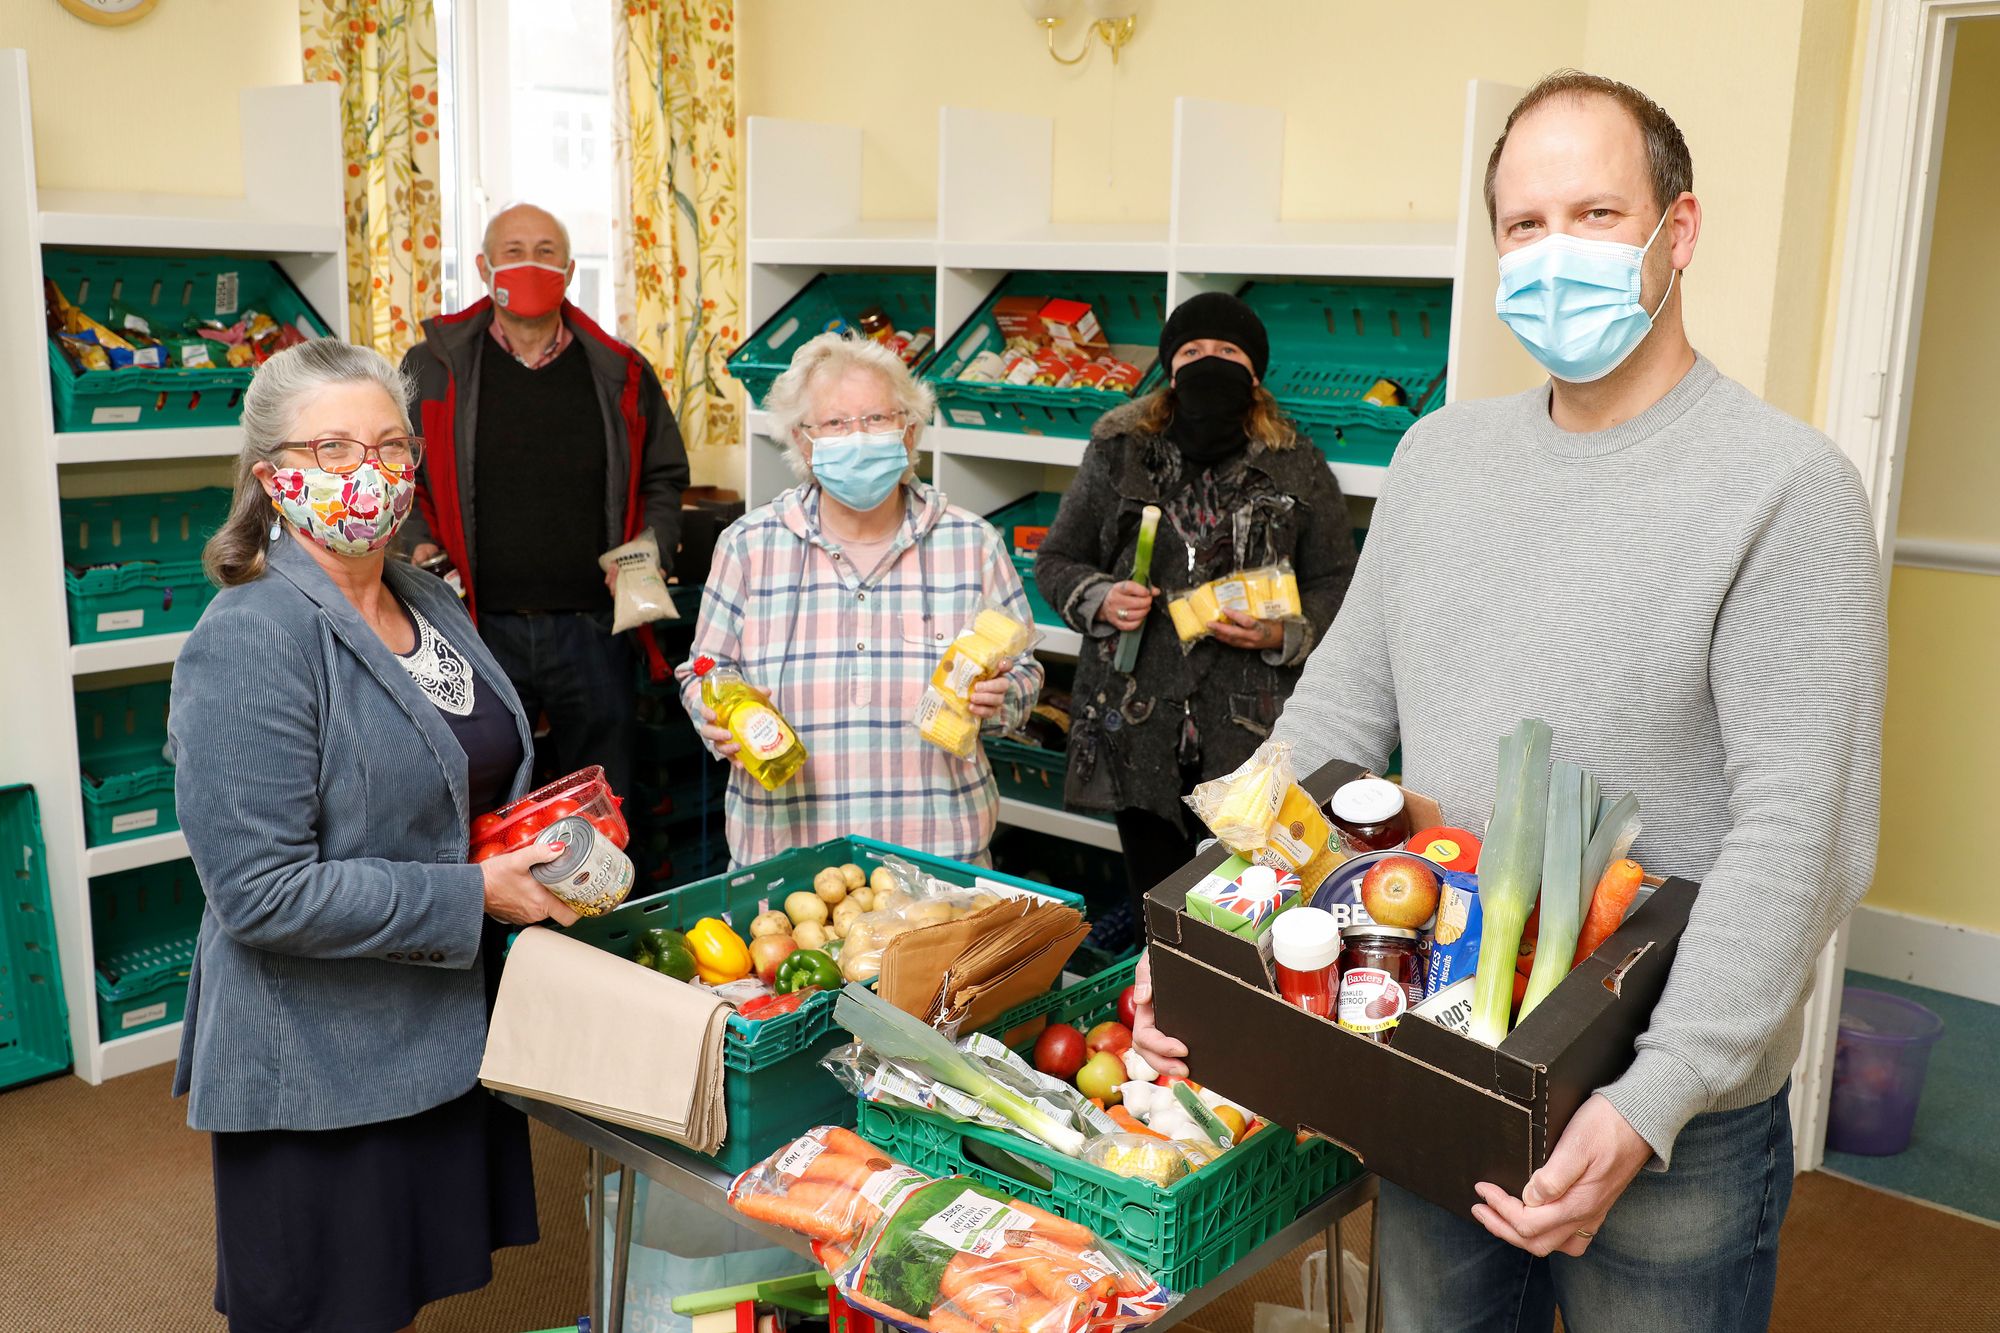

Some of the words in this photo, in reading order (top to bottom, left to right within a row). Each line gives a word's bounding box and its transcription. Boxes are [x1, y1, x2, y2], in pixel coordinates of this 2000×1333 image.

[565, 853, 613, 900] WEETCORN
[1347, 973, 1383, 985] Baxters
[1439, 954, 1453, 983] biscuits
[938, 1203, 964, 1220] TESCO
[950, 1206, 978, 1231] BRITISH
[953, 1206, 992, 1234] CRROTS
